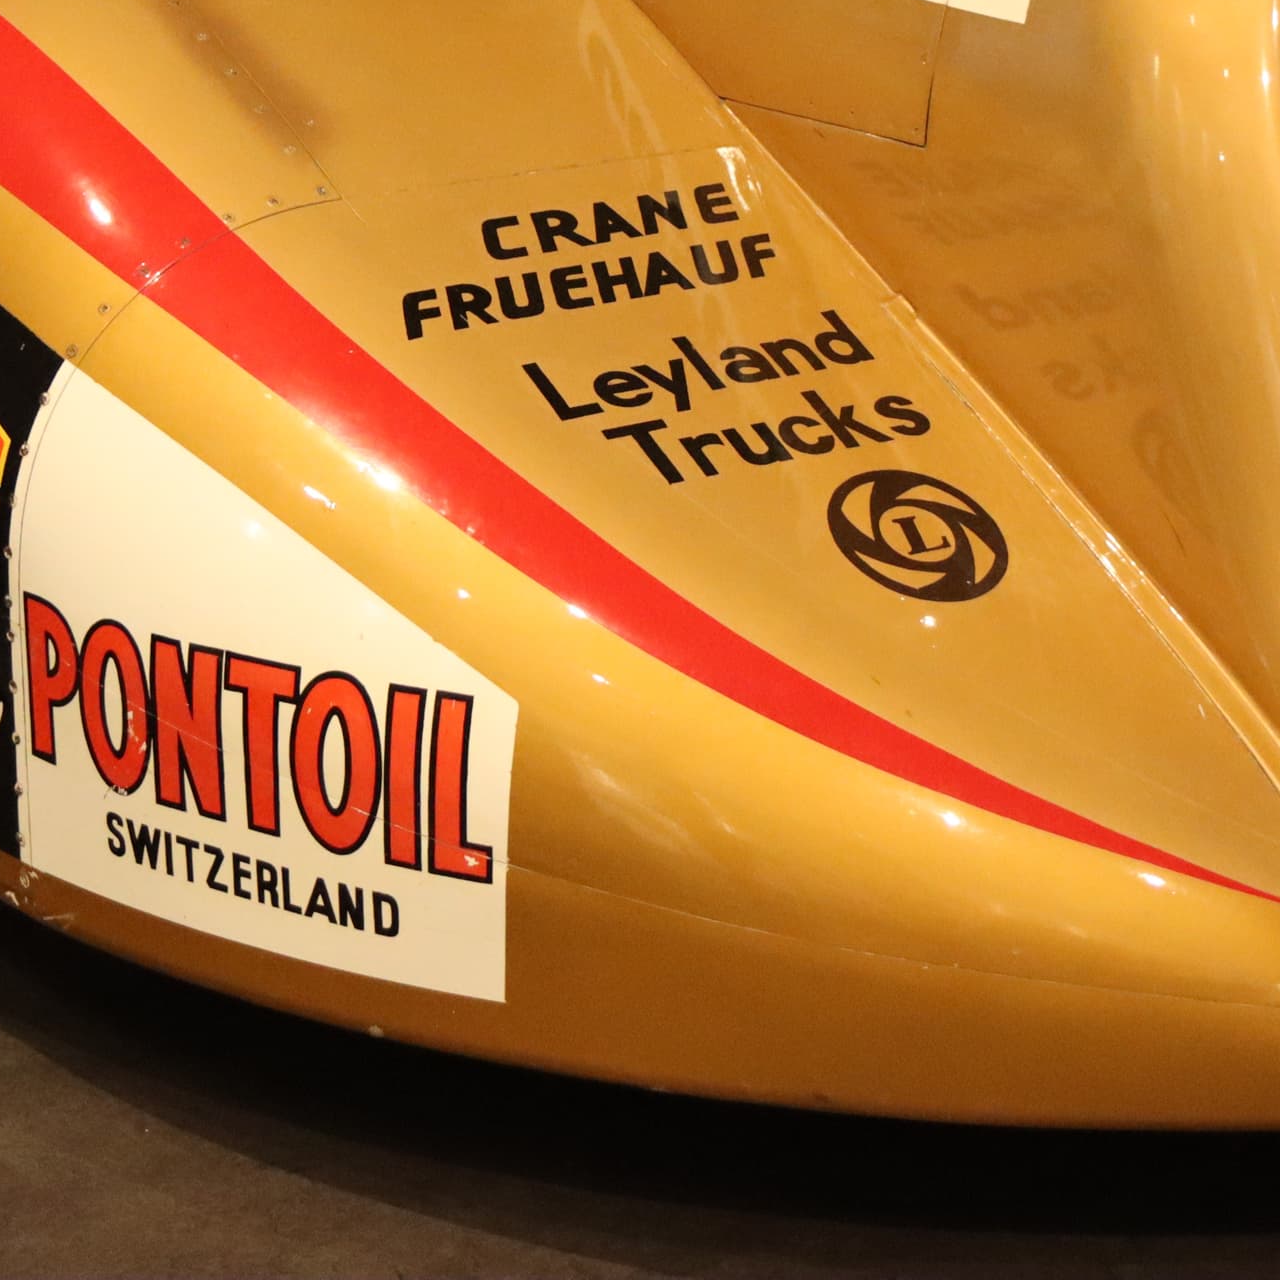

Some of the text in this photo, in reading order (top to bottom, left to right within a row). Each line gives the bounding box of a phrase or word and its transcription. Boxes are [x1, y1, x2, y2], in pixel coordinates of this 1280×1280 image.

[481, 181, 740, 261] CRANE
[401, 233, 779, 341] FRUEHAUF
[521, 309, 876, 422] Leyland
[602, 389, 932, 486] Trucks
[22, 590, 494, 885] PONTOIL
[105, 811, 401, 939] SWITZERLAND
